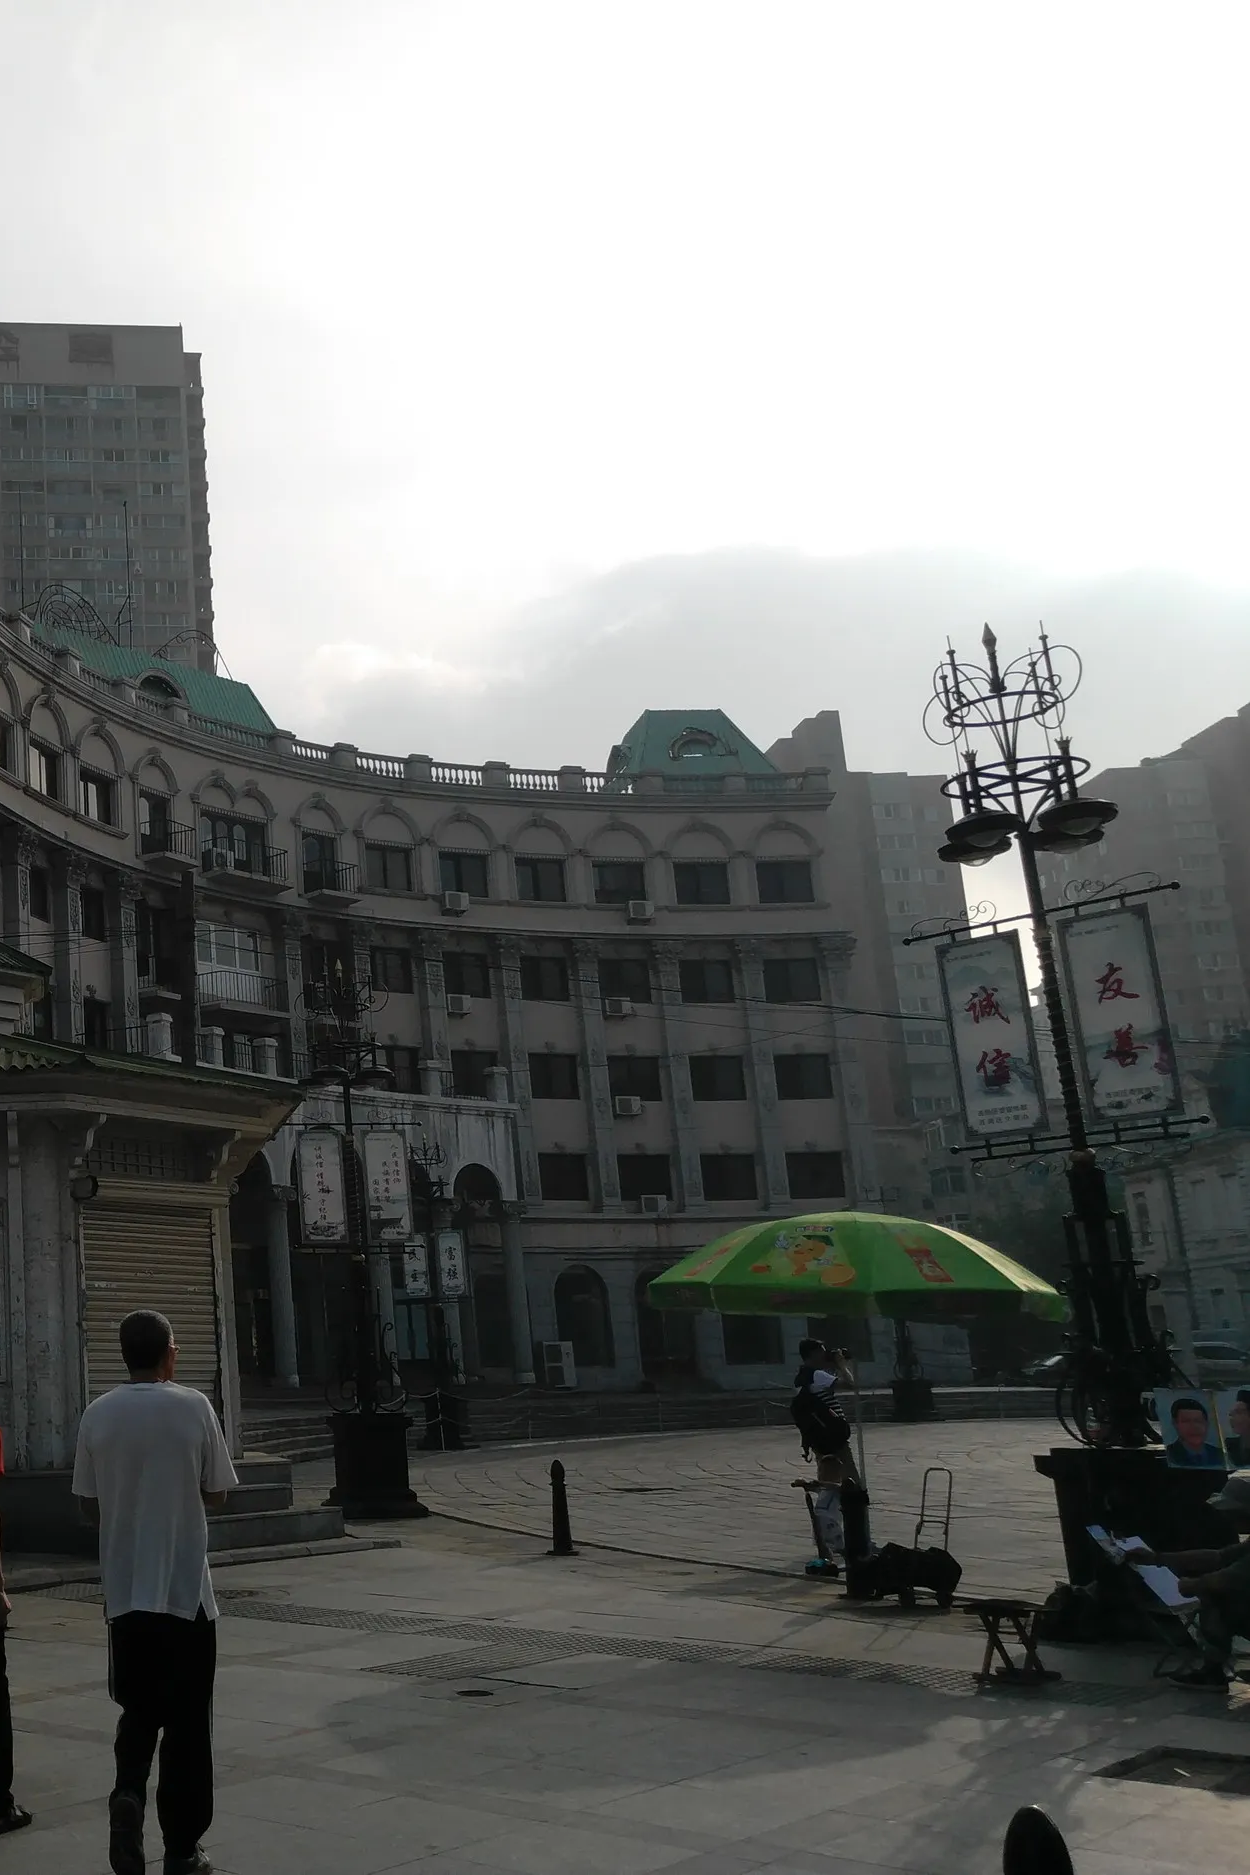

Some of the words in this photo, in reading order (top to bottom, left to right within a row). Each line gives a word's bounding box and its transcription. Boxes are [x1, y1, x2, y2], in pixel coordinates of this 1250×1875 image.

[966, 986, 1012, 1089] 诚信
[1095, 962, 1148, 1068] 友善
[408, 1248, 421, 1283] 民主
[444, 1246, 459, 1281] 富强
